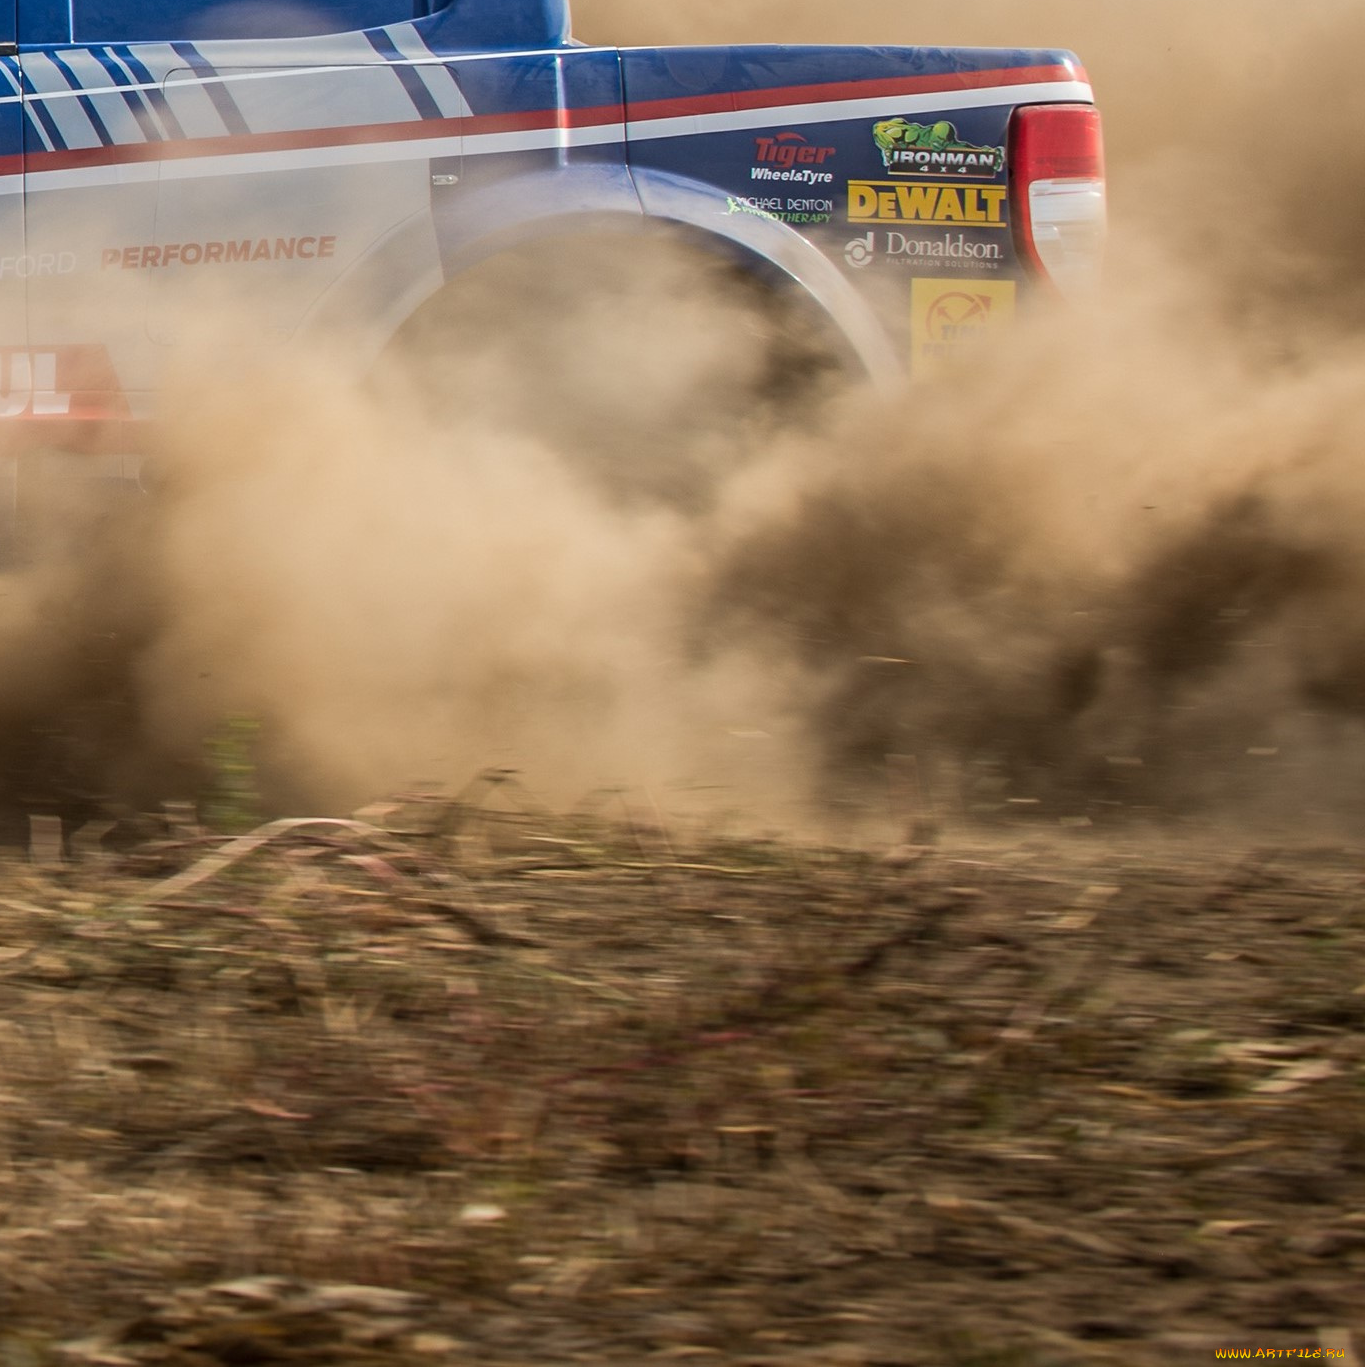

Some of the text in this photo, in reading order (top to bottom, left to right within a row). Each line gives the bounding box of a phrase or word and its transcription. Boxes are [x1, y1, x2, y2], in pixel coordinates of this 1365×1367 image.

[753, 132, 836, 169] Tiger
[893, 150, 995, 166] IRONMAN
[750, 167, 833, 184] Wheel&Tyre
[919, 165, 929, 173] 4
[957, 166, 967, 174] 4
[787, 198, 833, 211] DENTON
[100, 235, 336, 271] PERFORMANCE
[886, 232, 999, 259] Donaldson
